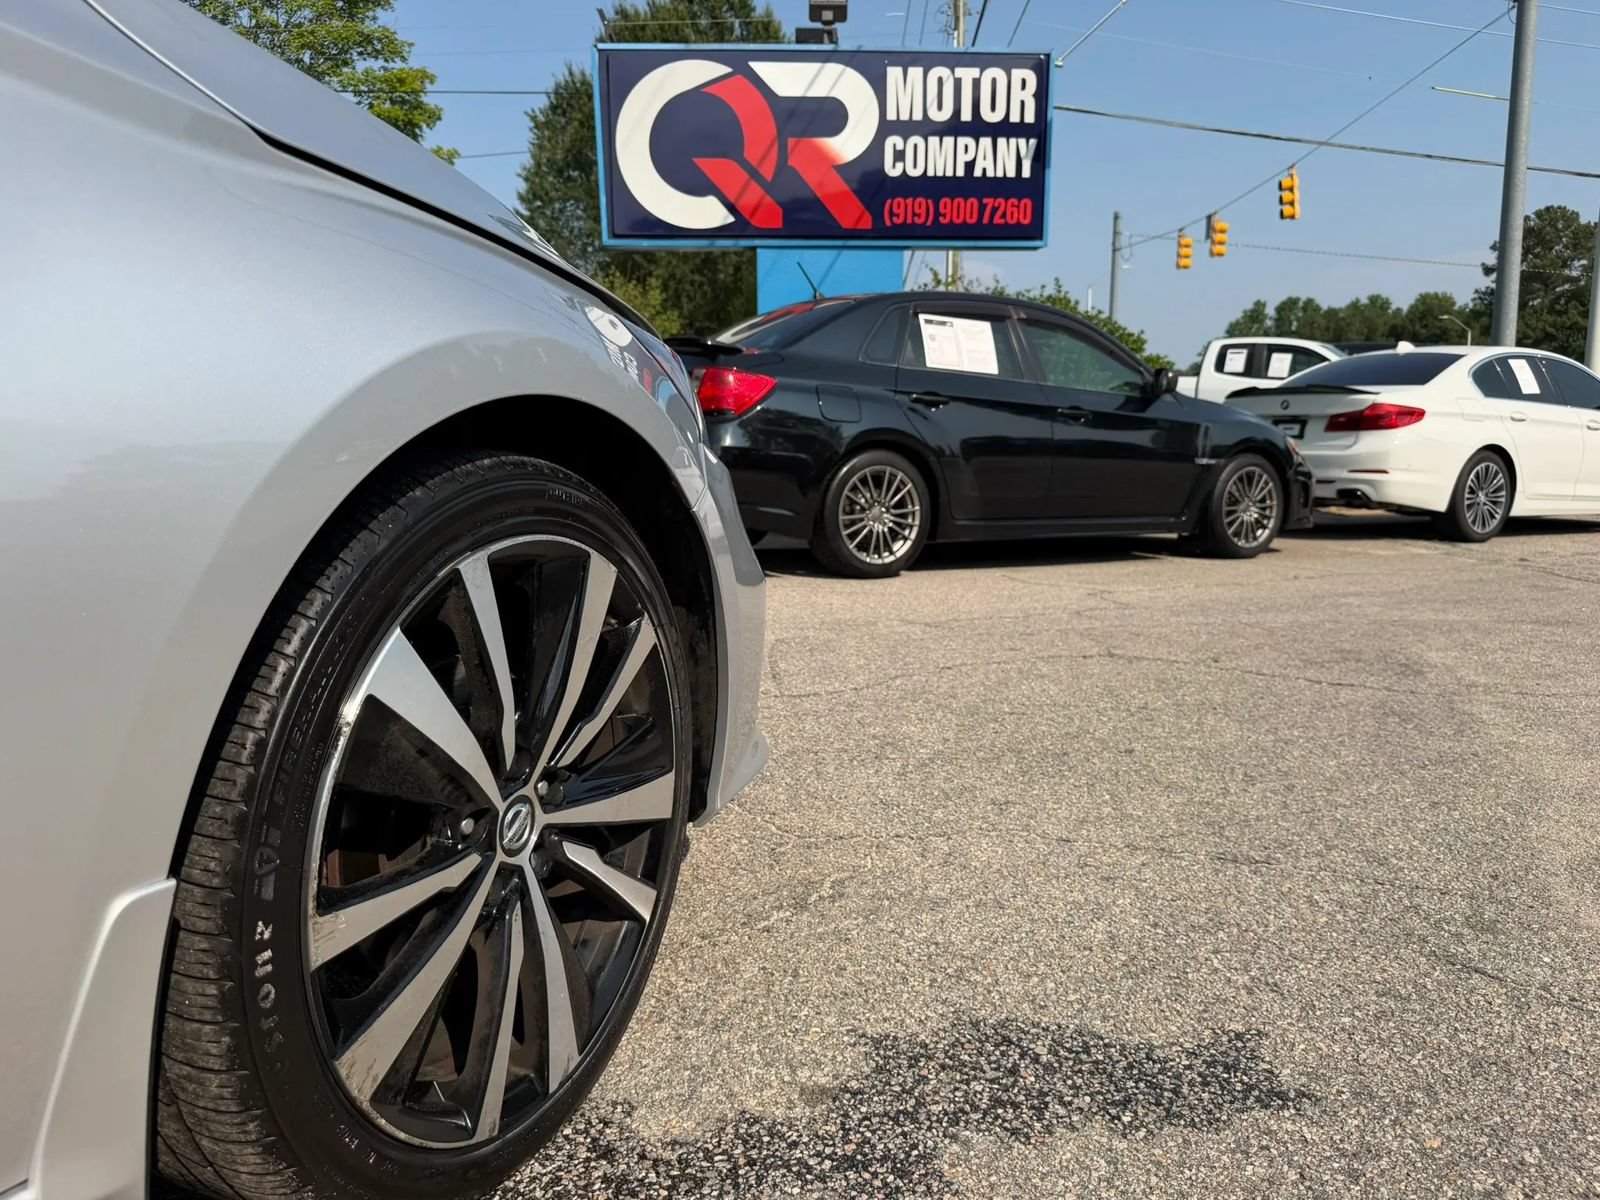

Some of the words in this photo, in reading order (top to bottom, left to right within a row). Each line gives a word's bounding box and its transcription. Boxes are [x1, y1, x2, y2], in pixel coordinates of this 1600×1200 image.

[886, 65, 1038, 124] MOTOR
[883, 134, 1038, 179] COMPANY
[883, 196, 935, 227] (919)
[938, 197, 980, 225] 900
[981, 197, 1033, 226] 7260
